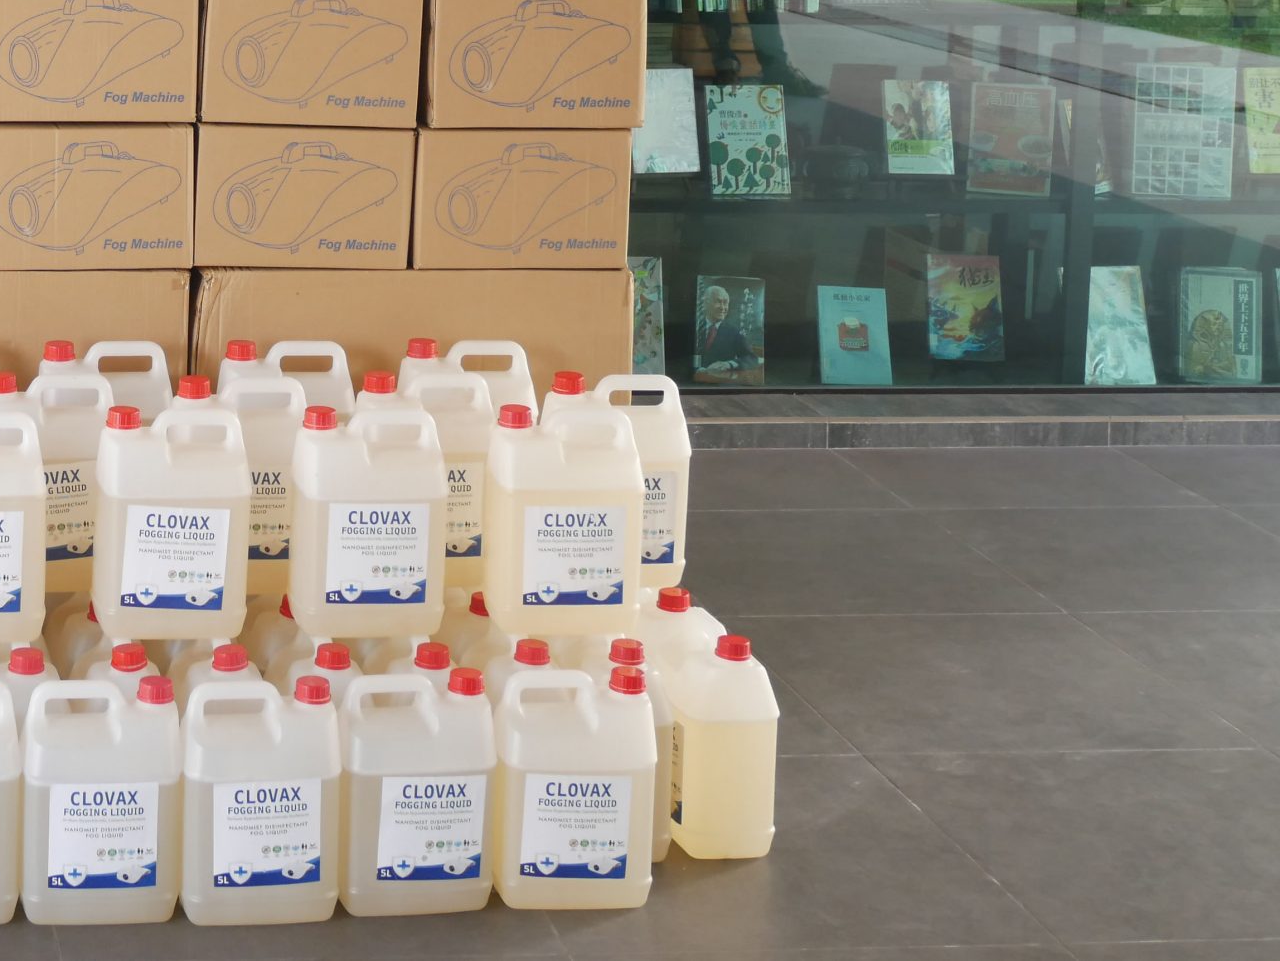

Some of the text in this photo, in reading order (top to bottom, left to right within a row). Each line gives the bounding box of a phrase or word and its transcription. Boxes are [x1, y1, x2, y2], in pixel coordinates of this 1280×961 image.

[104, 91, 185, 105] Fog Machine
[326, 95, 406, 109] Fog Machine
[552, 97, 631, 111] Fog Machine
[103, 239, 184, 252] Fog Machine
[318, 239, 397, 253] Fog Machine
[538, 238, 618, 252] Fog Machine
[146, 513, 210, 530] CLOVAX
[348, 511, 411, 525] CLOVAX
[544, 513, 608, 527] CLOVAX
[139, 529, 215, 541] FOGGING LIQUID
[341, 526, 417, 535] FOGGING LIQUID
[538, 529, 613, 538] FOGGING LIQUID
[124, 595, 134, 605] 5L
[526, 595, 538, 603] 5L
[234, 787, 302, 804] CLOVAX
[402, 783, 467, 799] CLOVAX
[546, 782, 612, 797] CLOVAX
[70, 791, 138, 806] CLOVAX
[395, 799, 472, 809] FOGGING LIQUID
[538, 799, 617, 808] FOGGING LIQUID
[64, 807, 144, 817] FOGGING LIQUID
[228, 803, 308, 815] FOGGING LIQUID
[524, 865, 535, 873] 5L
[217, 875, 229, 885] 5L
